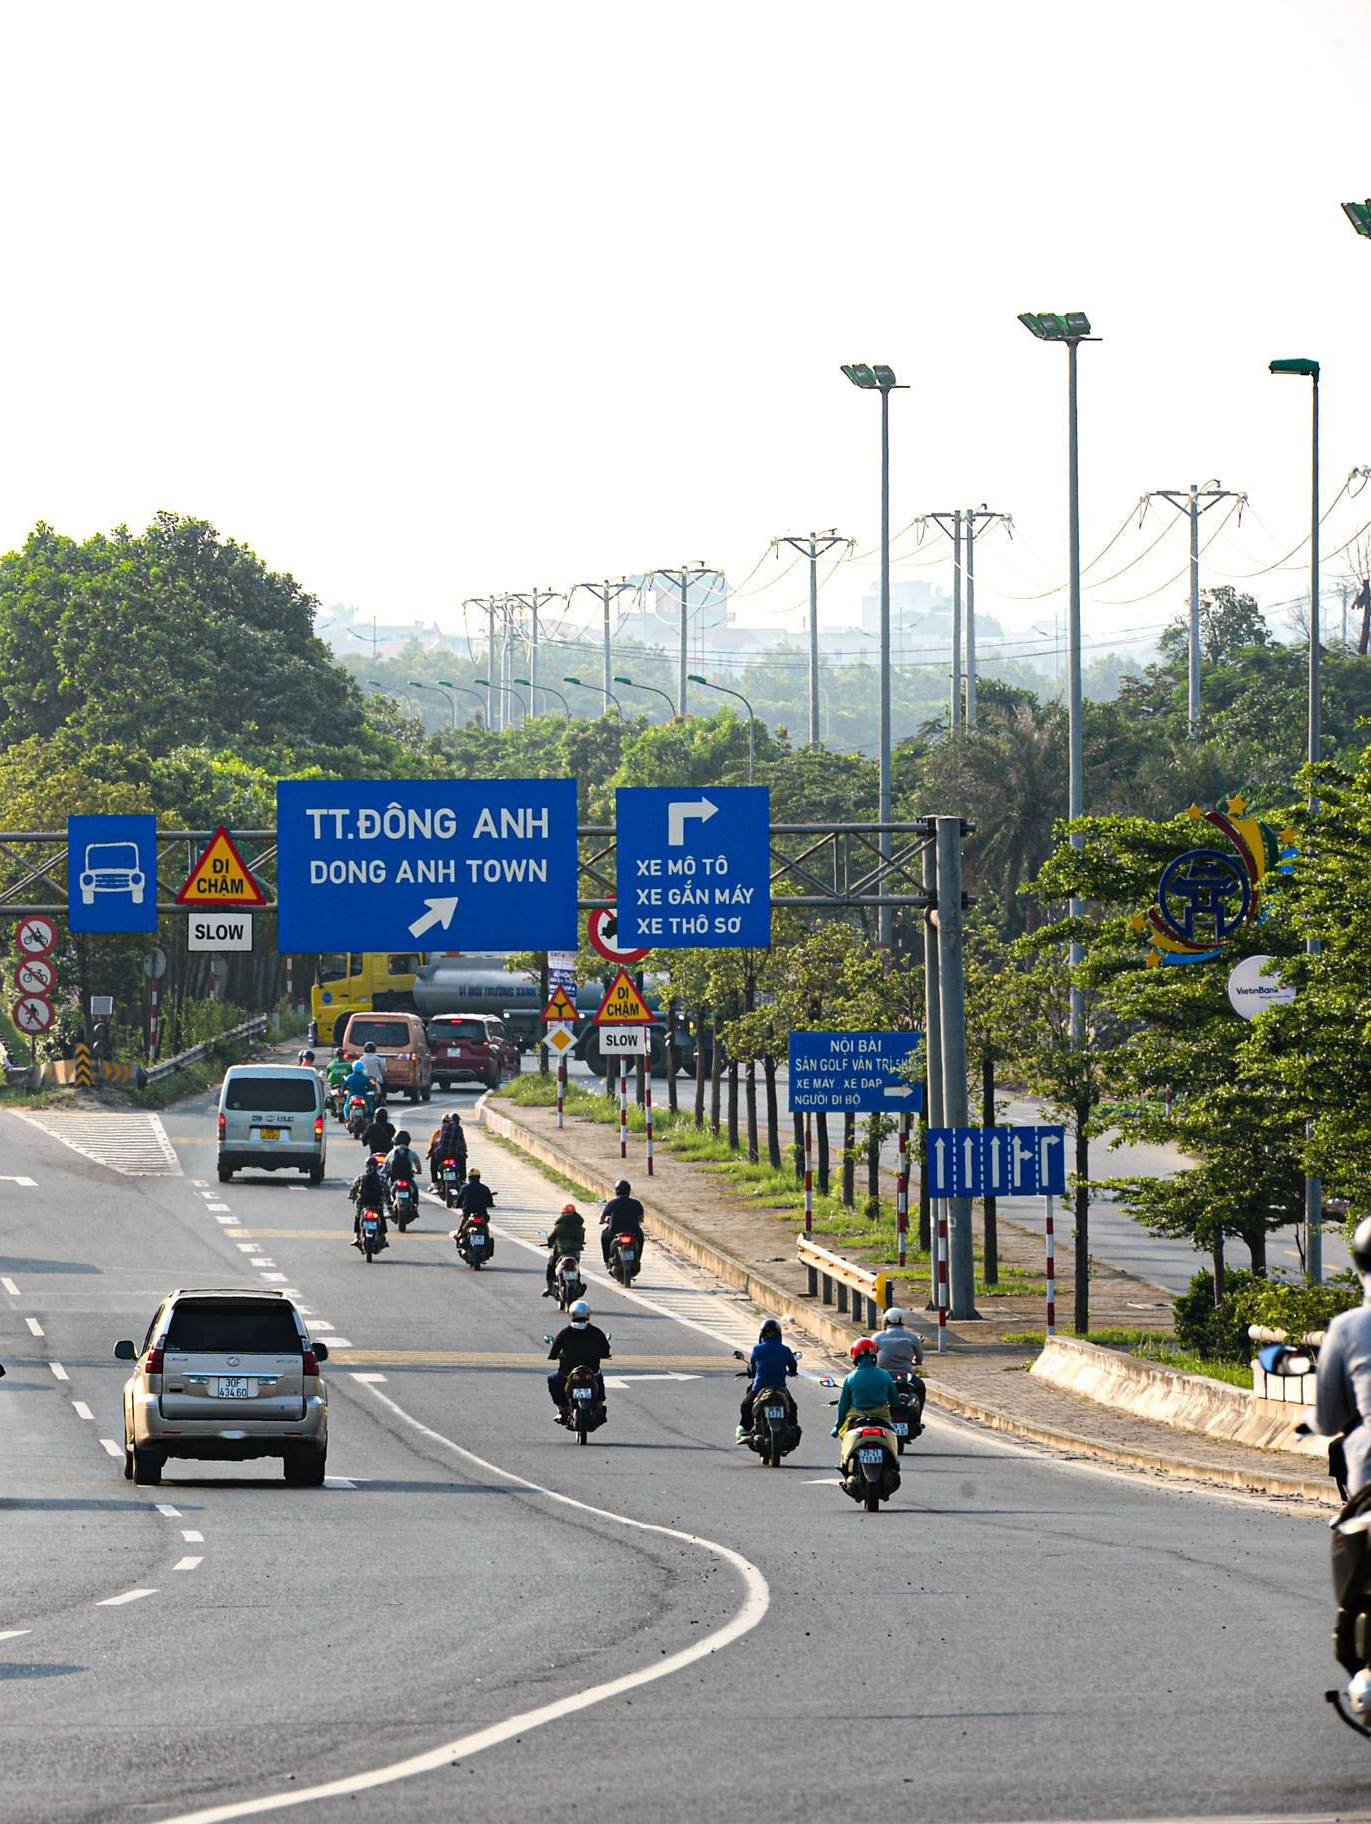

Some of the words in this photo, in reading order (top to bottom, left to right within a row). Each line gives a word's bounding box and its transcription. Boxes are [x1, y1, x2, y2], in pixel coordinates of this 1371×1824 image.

[472, 807, 549, 839] ANH
[212, 858, 229, 874] ĐI
[310, 860, 387, 885] DONG
[395, 860, 456, 883] ANH
[465, 859, 547, 883] TOWN
[636, 859, 662, 876] XE
[668, 855, 696, 876] MÔ
[702, 854, 728, 876] TÔ
[196, 875, 244, 897] CHẬM
[636, 888, 662, 905] XE
[668, 880, 709, 905] GẮN
[715, 884, 754, 905] MÁY
[195, 924, 244, 940] SLOW
[637, 918, 663, 934] XE
[669, 914, 709, 934] THÔ
[714, 916, 742, 934] SƠ
[606, 1002, 639, 1018] CHẬM
[606, 1034, 638, 1046] SLOW
[830, 1037, 854, 1055] NỘI
[858, 1036, 882, 1053] BÀI
[795, 1056, 817, 1072] SÂN
[820, 1058, 848, 1071] GOLF
[852, 1056, 873, 1071] VÂN
[796, 1079, 810, 1089] XE
[813, 1075, 835, 1089] MÁY
[843, 1079, 857, 1089] XE
[795, 1092, 828, 1105] NGƯỜI
[845, 1091, 861, 1107] BỘ
[225, 1378, 240, 1387] 30F
